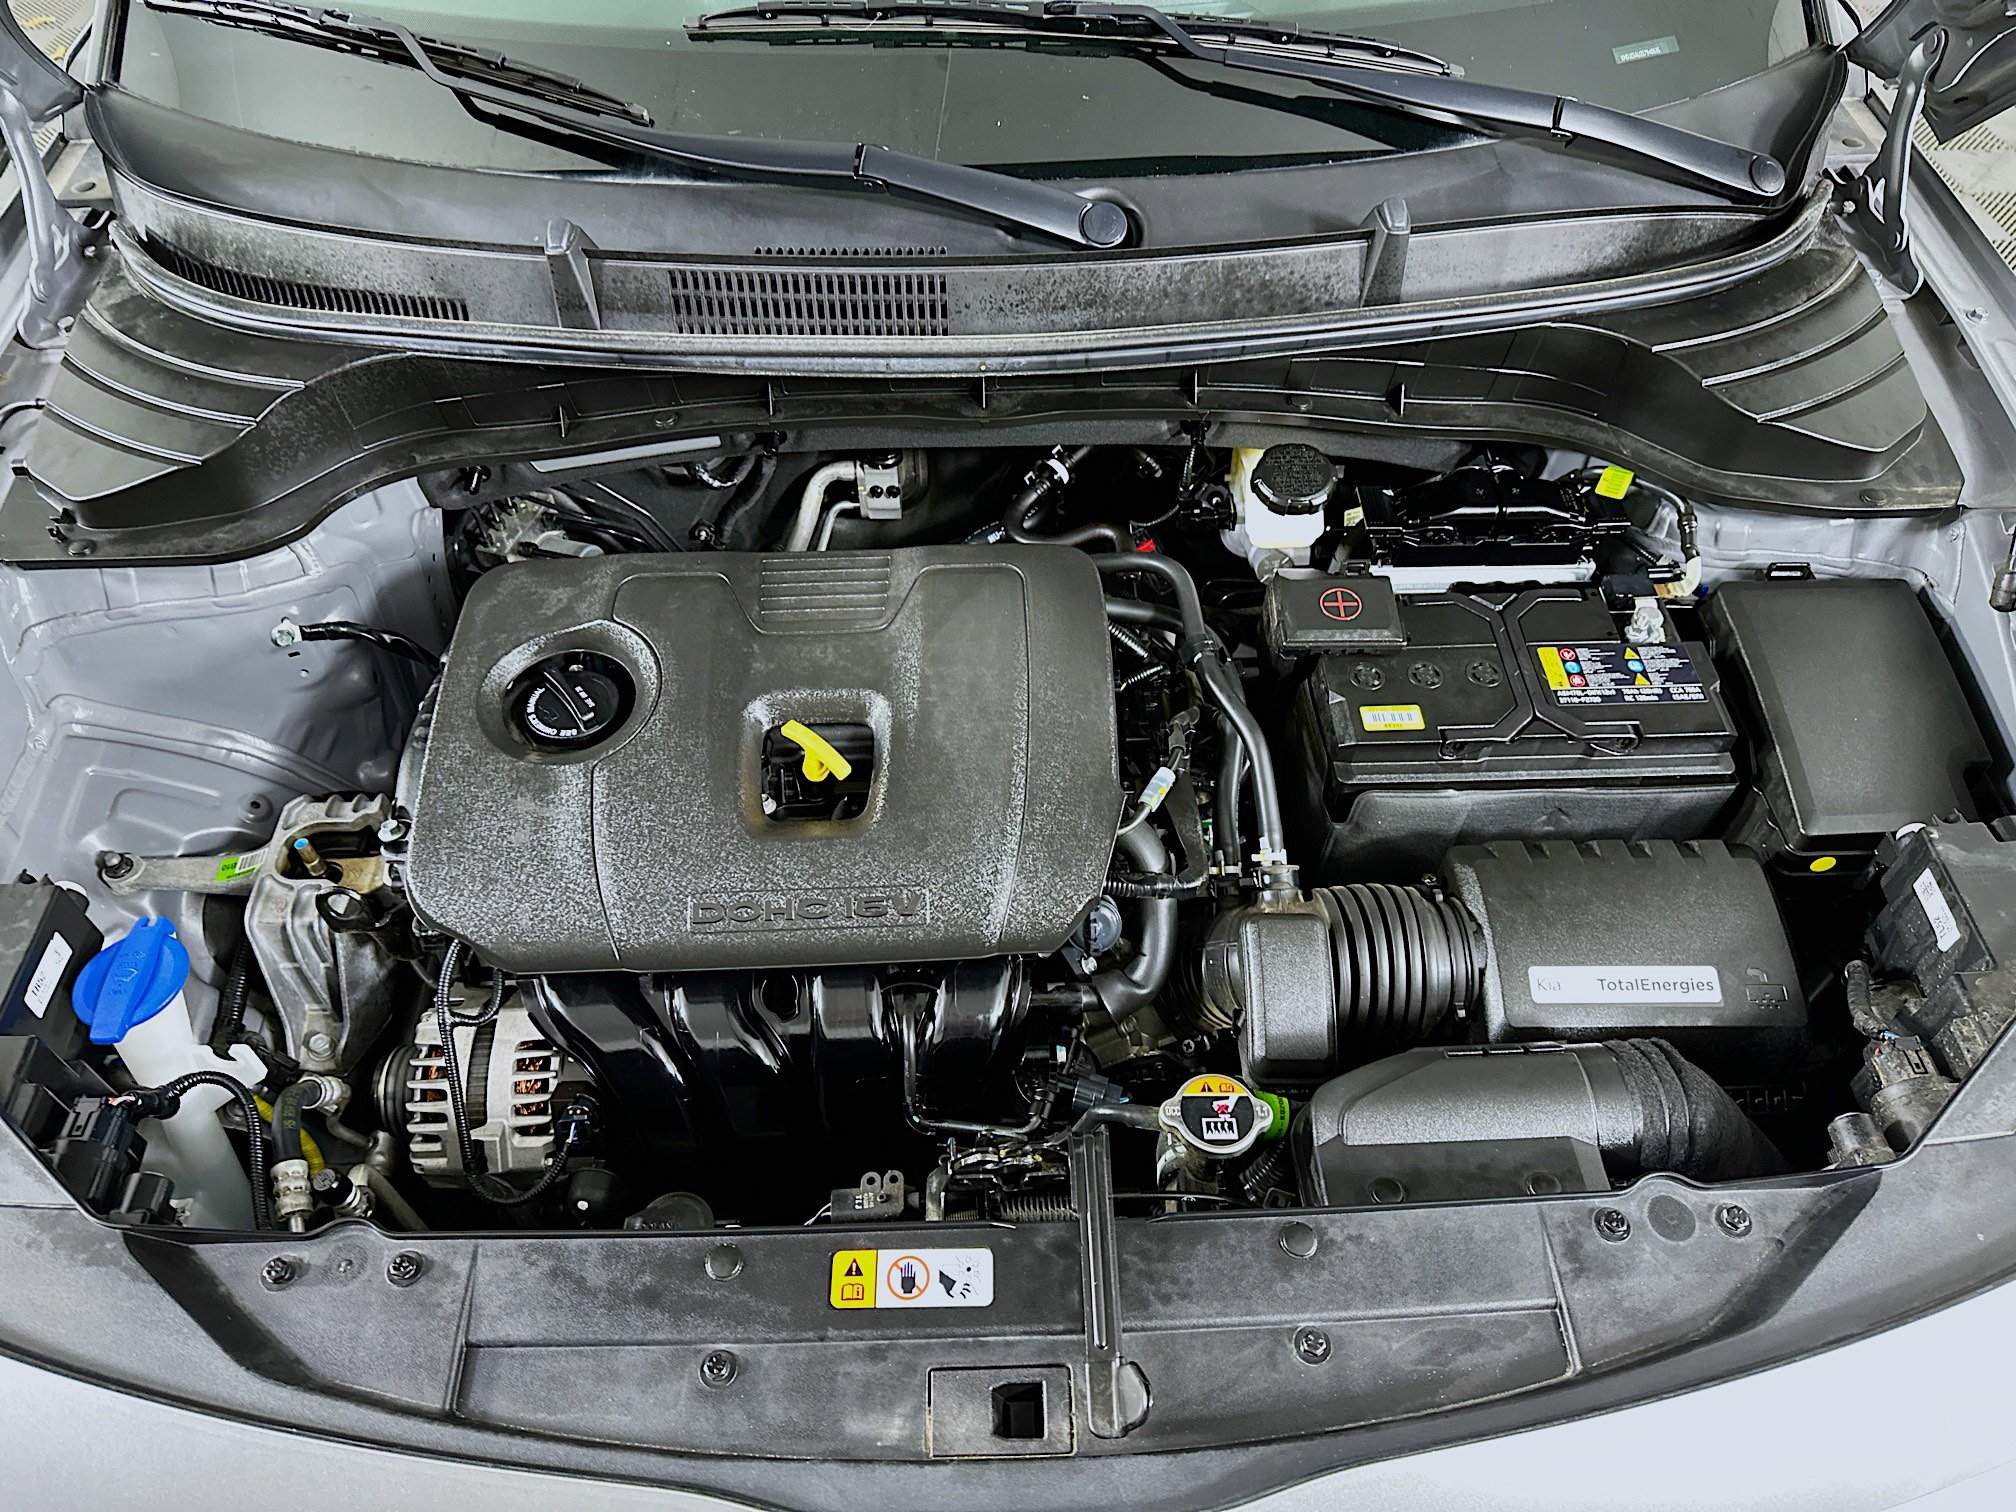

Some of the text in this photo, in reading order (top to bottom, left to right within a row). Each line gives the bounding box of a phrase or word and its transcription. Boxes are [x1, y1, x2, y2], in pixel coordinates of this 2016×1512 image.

[691, 893, 923, 924] DOHC 16V
[1536, 978, 1714, 994] Kia TotalEnergies
